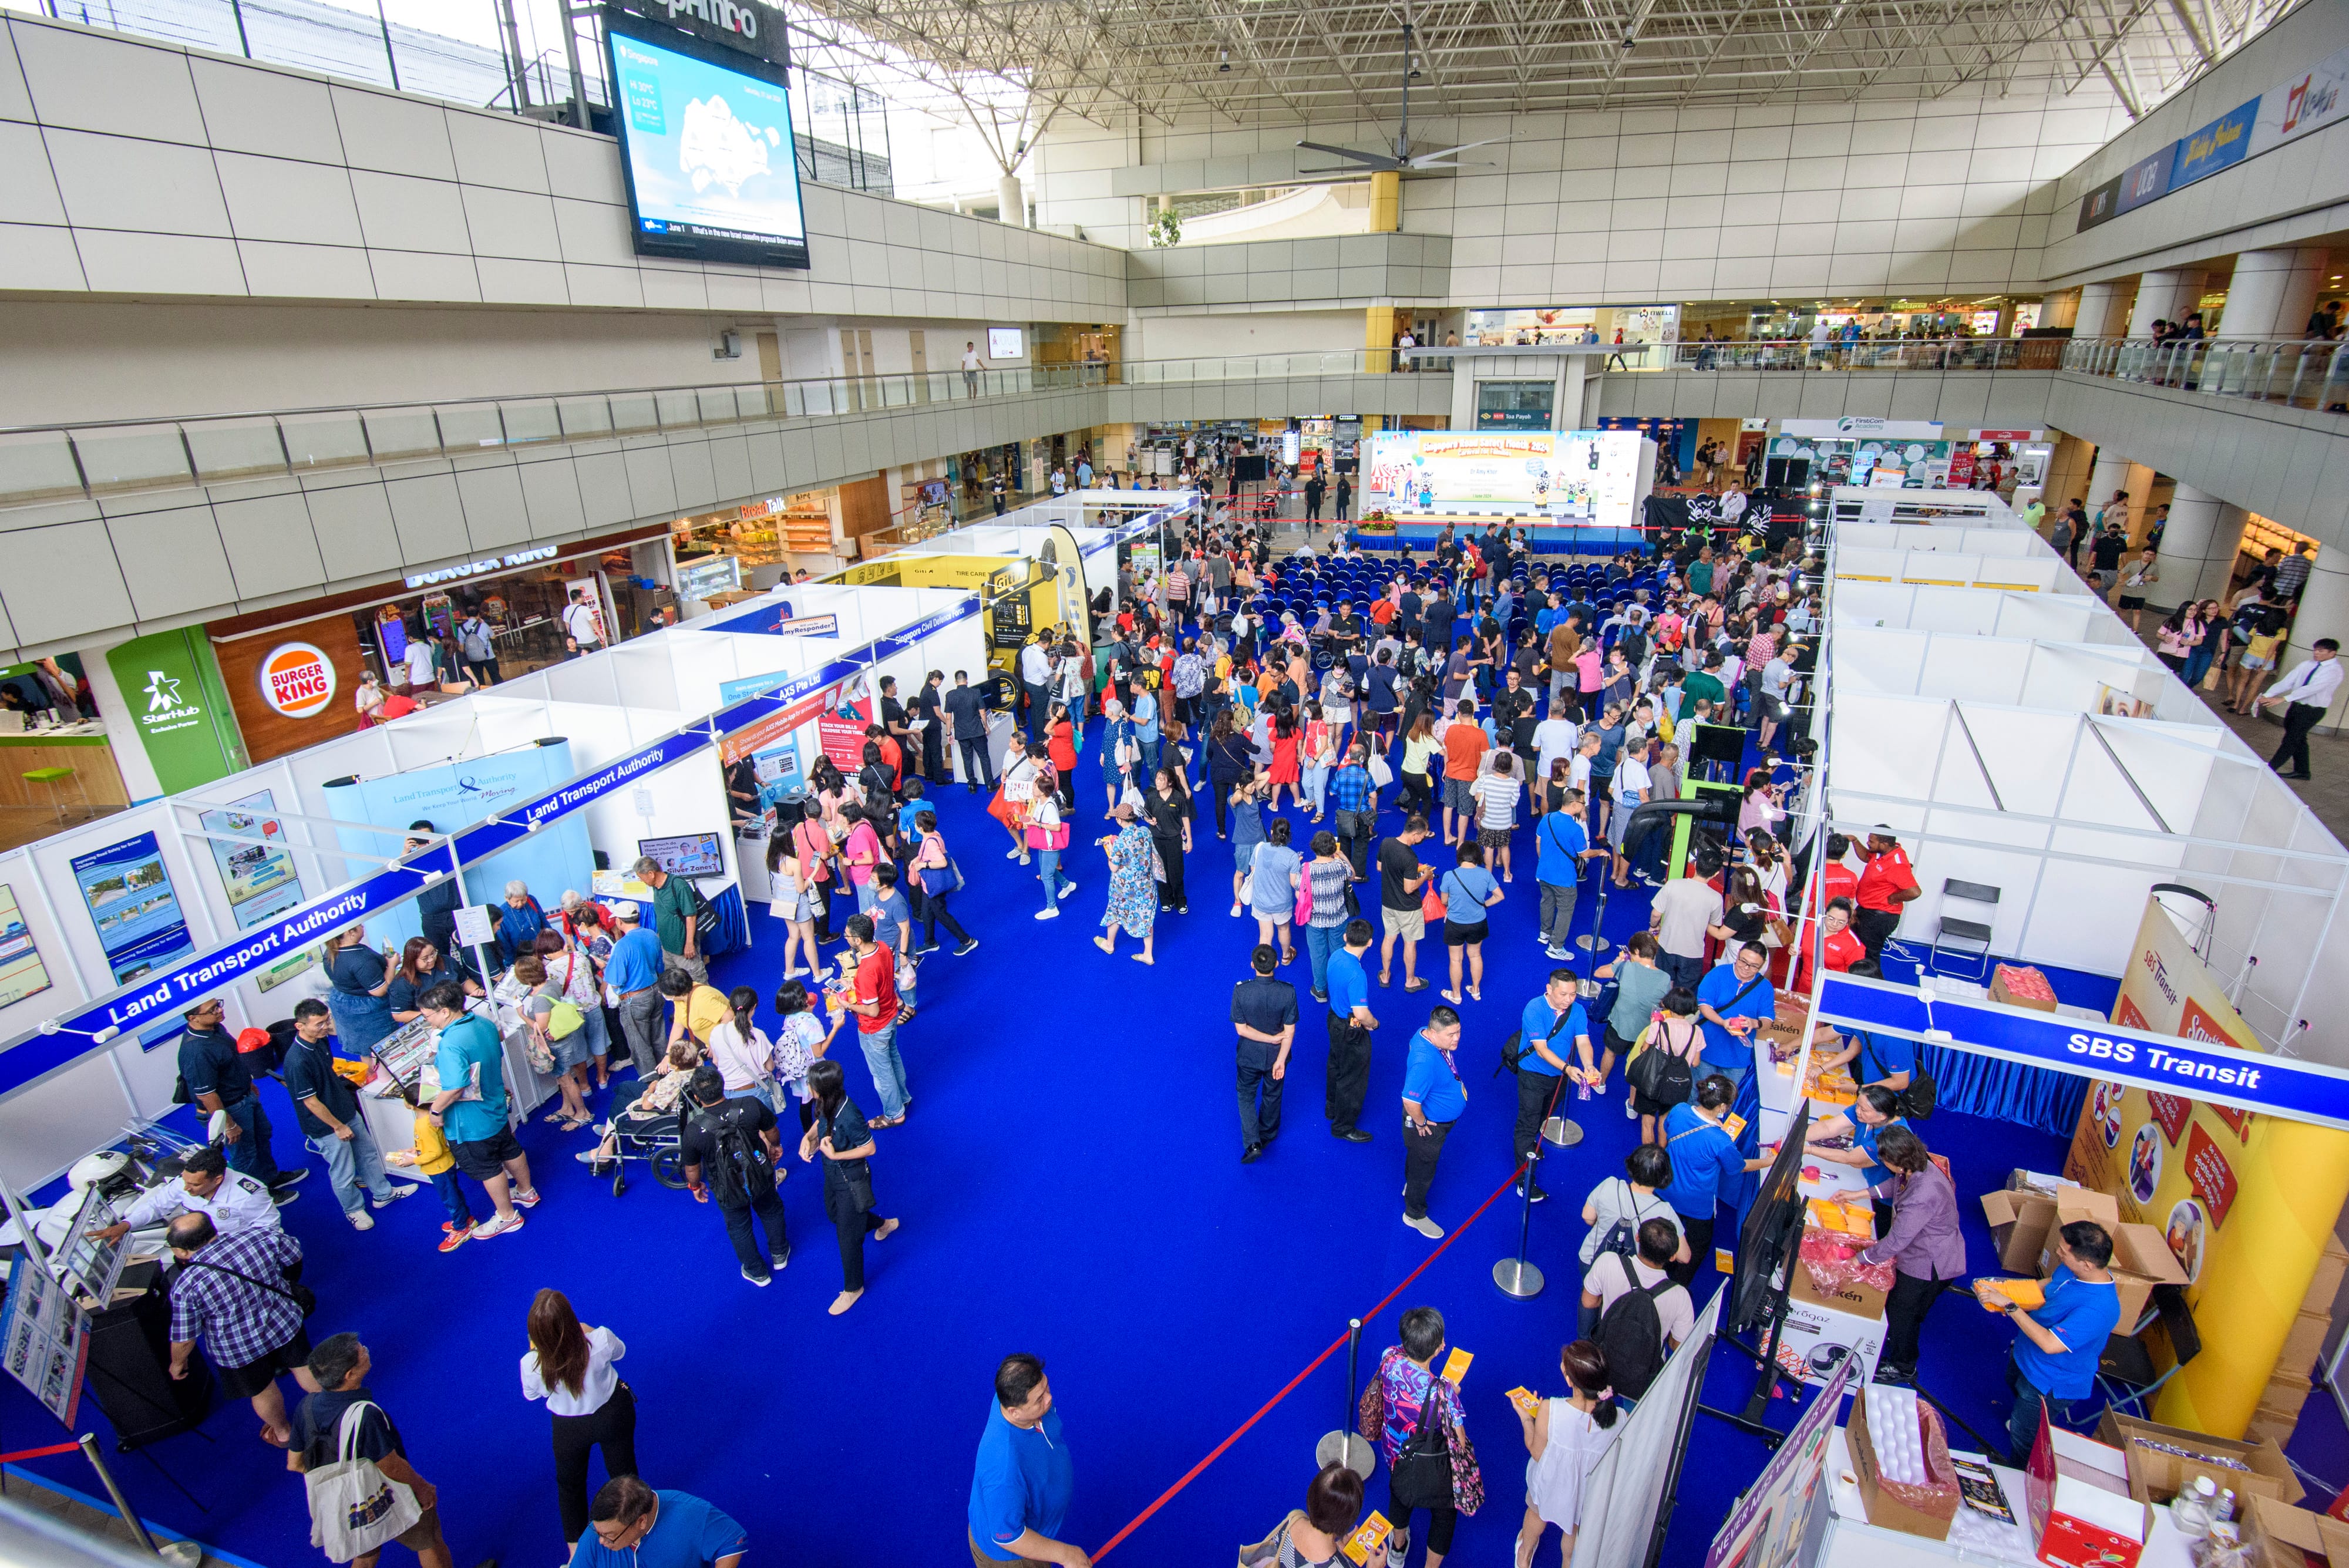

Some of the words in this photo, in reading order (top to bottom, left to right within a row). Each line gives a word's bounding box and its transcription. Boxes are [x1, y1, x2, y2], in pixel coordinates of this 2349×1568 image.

[627, 48, 659, 66] Singapore
[632, 96, 641, 105] Lo
[2136, 160, 2159, 197] UOB
[669, 223, 681, 233] June
[1423, 440, 1460, 454] Singapore
[1459, 438, 1479, 449] Road
[1479, 439, 1504, 451] Safety
[1504, 439, 1529, 450] Month
[1529, 441, 1550, 454] 2024
[1490, 449, 1513, 457] Families
[741, 497, 786, 520] BreadTalk
[997, 573, 1015, 589] Giti
[784, 623, 835, 635] myResponder?
[895, 627, 921, 645] Singapore
[921, 621, 933, 632] Civil
[933, 614, 952, 627] Defence
[952, 607, 965, 618] Force
[271, 664, 323, 688] BURGER
[275, 675, 327, 704] KING
[779, 686, 795, 701] AXS
[796, 681, 809, 694] Pte
[809, 674, 821, 687] Ltd
[142, 706, 200, 725] StarHub
[150, 722, 177, 734] Exclusive
[177, 719, 199, 729] Partner
[739, 738, 752, 746] Show
[756, 728, 766, 738] your
[765, 723, 775, 732] AXS
[775, 717, 788, 728] Mobile
[788, 712, 796, 722] App
[393, 793, 416, 803] Land
[417, 784, 458, 799] Transport
[477, 773, 517, 786] Authority
[478, 786, 518, 799] Moving
[526, 797, 560, 823] Land
[559, 769, 617, 806] Transport
[617, 748, 664, 780] Authority
[75, 853, 97, 866] Improving
[96, 849, 107, 857] Road
[107, 846, 121, 855] Safety
[127, 839, 142, 847] School
[77, 861, 95, 870] Children
[690, 863, 716, 872] Zones?
[107, 981, 172, 1025] Land
[173, 931, 281, 992] Transport
[282, 891, 368, 943] Authority
[115, 952, 136, 964] Improving
[136, 947, 147, 955] Road
[146, 943, 160, 951] Safety
[2144, 950, 2157, 973] SBS
[2153, 957, 2178, 1006] Transit
[401, 1050, 417, 1062] KNOW
[2067, 1032, 2135, 1064] SBS
[2146, 1047, 2262, 1089] Transit
[2154, 1096, 2165, 1115] safer
[2166, 1102, 2177, 1123] deck
[2193, 1153, 2213, 1183] seated
[2193, 1168, 2206, 1187] bus
[2200, 1148, 2210, 1165] Let's
[2209, 1160, 2226, 1191] remain
[1715, 1504, 1749, 1562] NEVER
[1749, 1474, 1773, 1509] MISS
[1775, 1433, 1802, 1473] YOUR
[1801, 1409, 1820, 1439] BUS
[1820, 1363, 1851, 1411] AGAIN!
[2051, 1520, 2081, 1535] LOVEAPPLE
